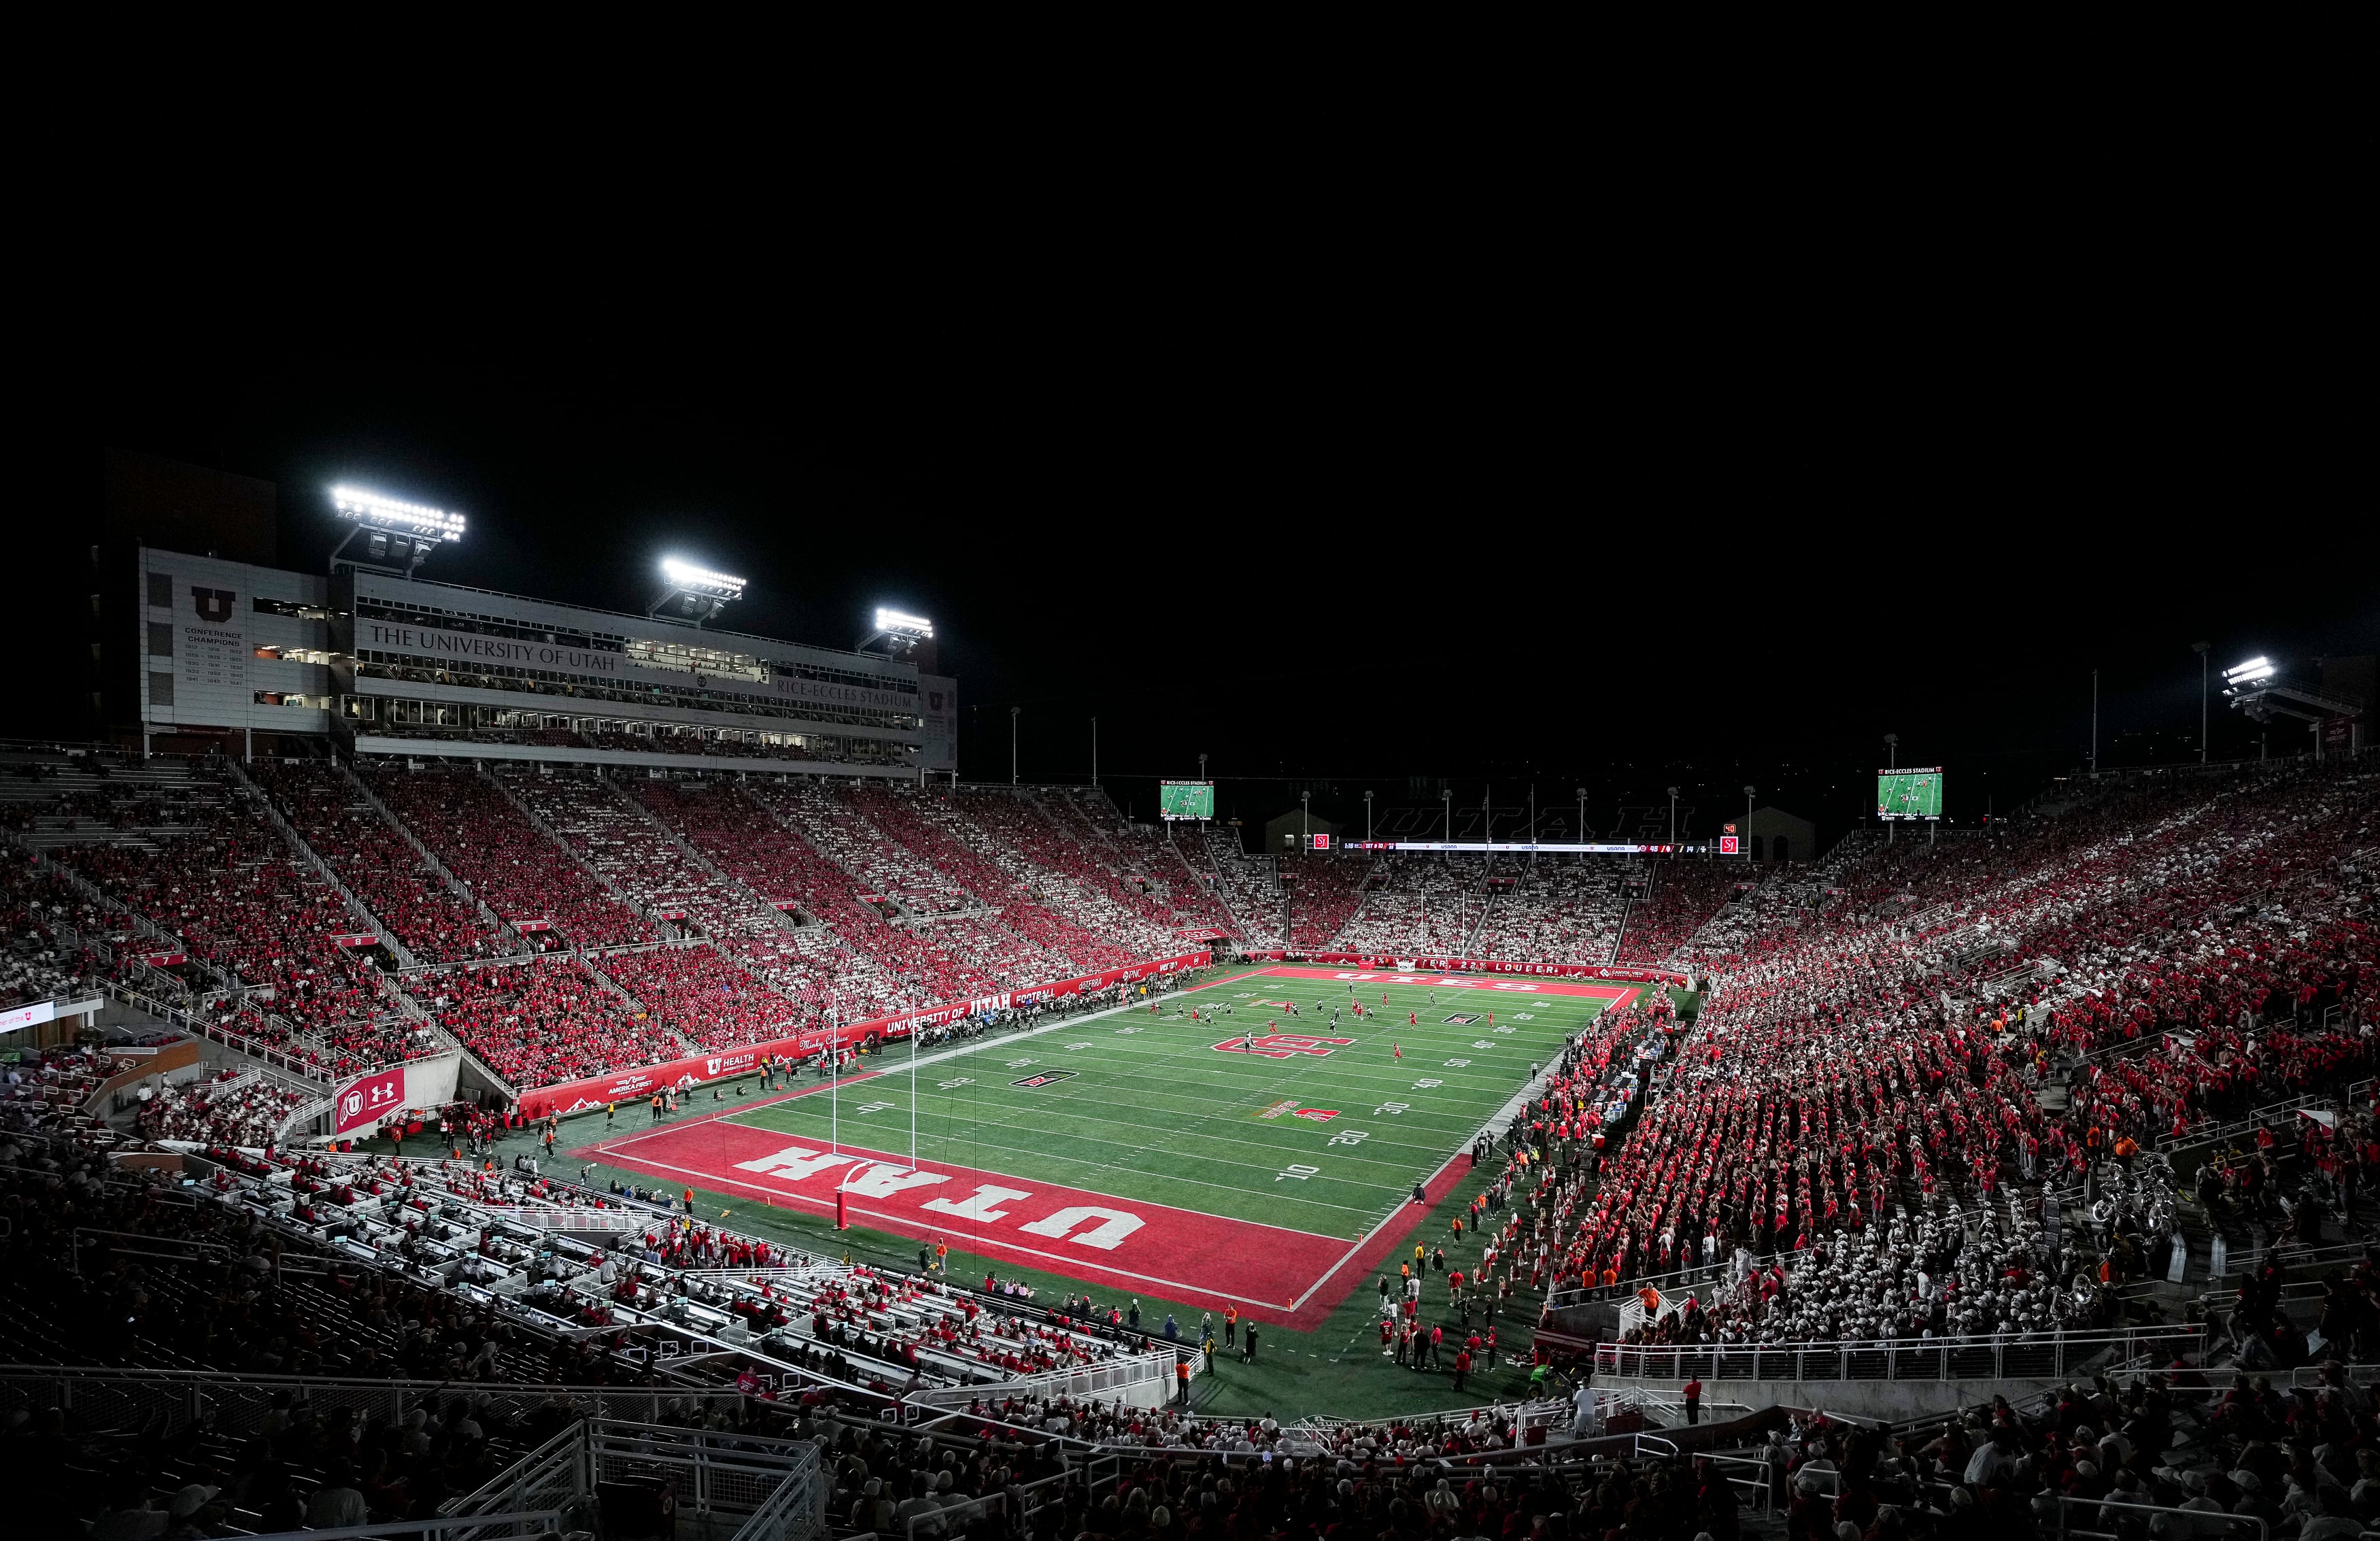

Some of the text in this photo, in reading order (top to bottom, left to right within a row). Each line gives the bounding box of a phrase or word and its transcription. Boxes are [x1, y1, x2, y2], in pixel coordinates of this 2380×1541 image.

[192, 586, 236, 623] U
[184, 627, 243, 639] CONFERENCE
[188, 636, 240, 647] CHAMPIONS
[371, 625, 615, 671] THE UNIVERSITY OF UTAH
[777, 679, 912, 708] RICE-ECCLES STADIUM
[163, 956, 169, 965] 7
[1128, 968, 1142, 979] PNC
[1333, 972, 1542, 991] UTES
[952, 1007, 965, 1019] OF
[799, 1038, 824, 1051] Minky
[723, 1053, 754, 1067] HEALTH
[1005, 1058, 1041, 1067] 30
[1442, 1058, 1472, 1068] 50
[608, 1079, 653, 1095] AMERICA FIRST
[936, 1077, 976, 1087] 20
[1414, 1078, 1444, 1089] 40
[381, 1098, 398, 1106] ARMOUR
[856, 1101, 895, 1112] 10
[1374, 1102, 1410, 1115] 30
[1329, 1130, 1370, 1145] 20
[1278, 1164, 1321, 1181] 10
[732, 1146, 1146, 1251] UTAH
